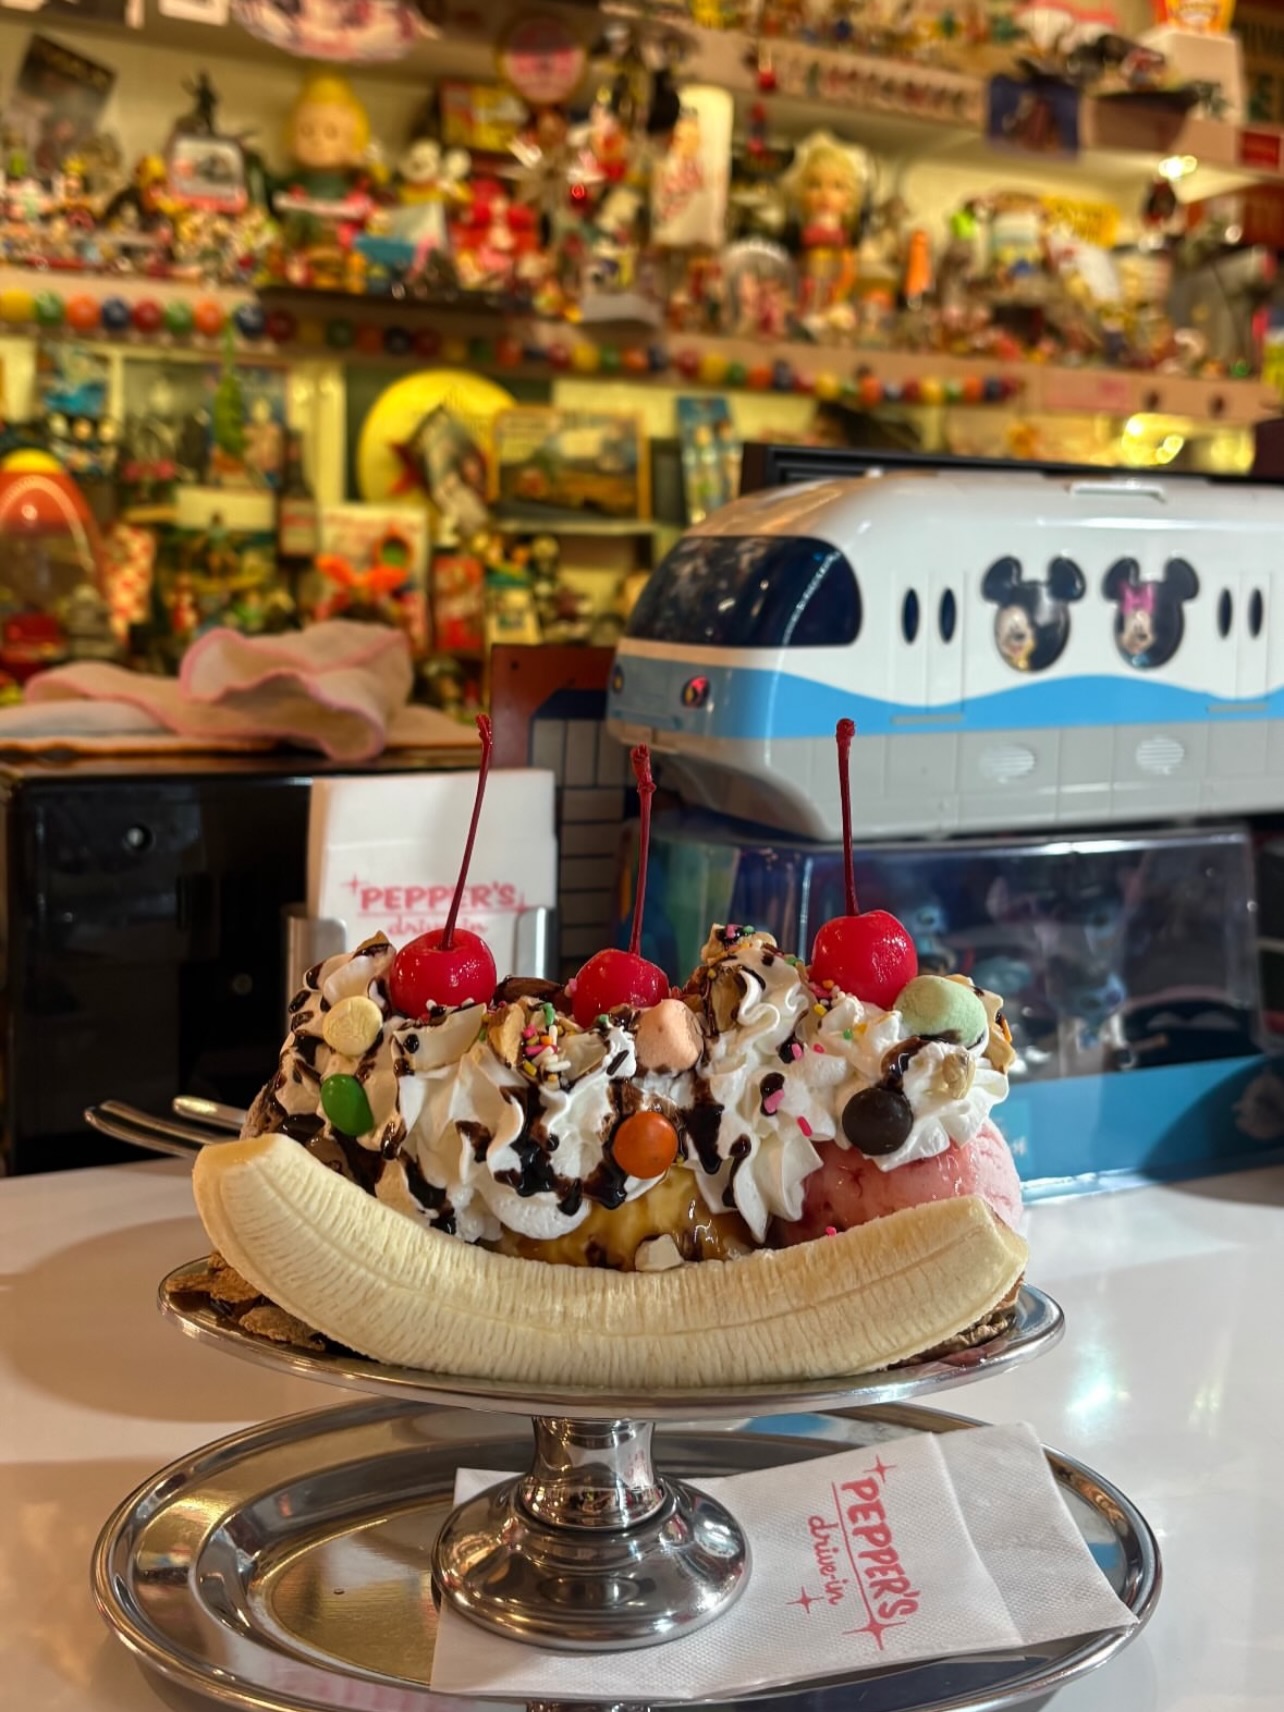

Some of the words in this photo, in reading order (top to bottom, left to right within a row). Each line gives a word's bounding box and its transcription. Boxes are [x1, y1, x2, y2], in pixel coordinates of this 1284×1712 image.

[388, 916, 487, 937] driin
[808, 1516, 849, 1605] drive-in
[841, 1477, 920, 1619] PEPPER'S
